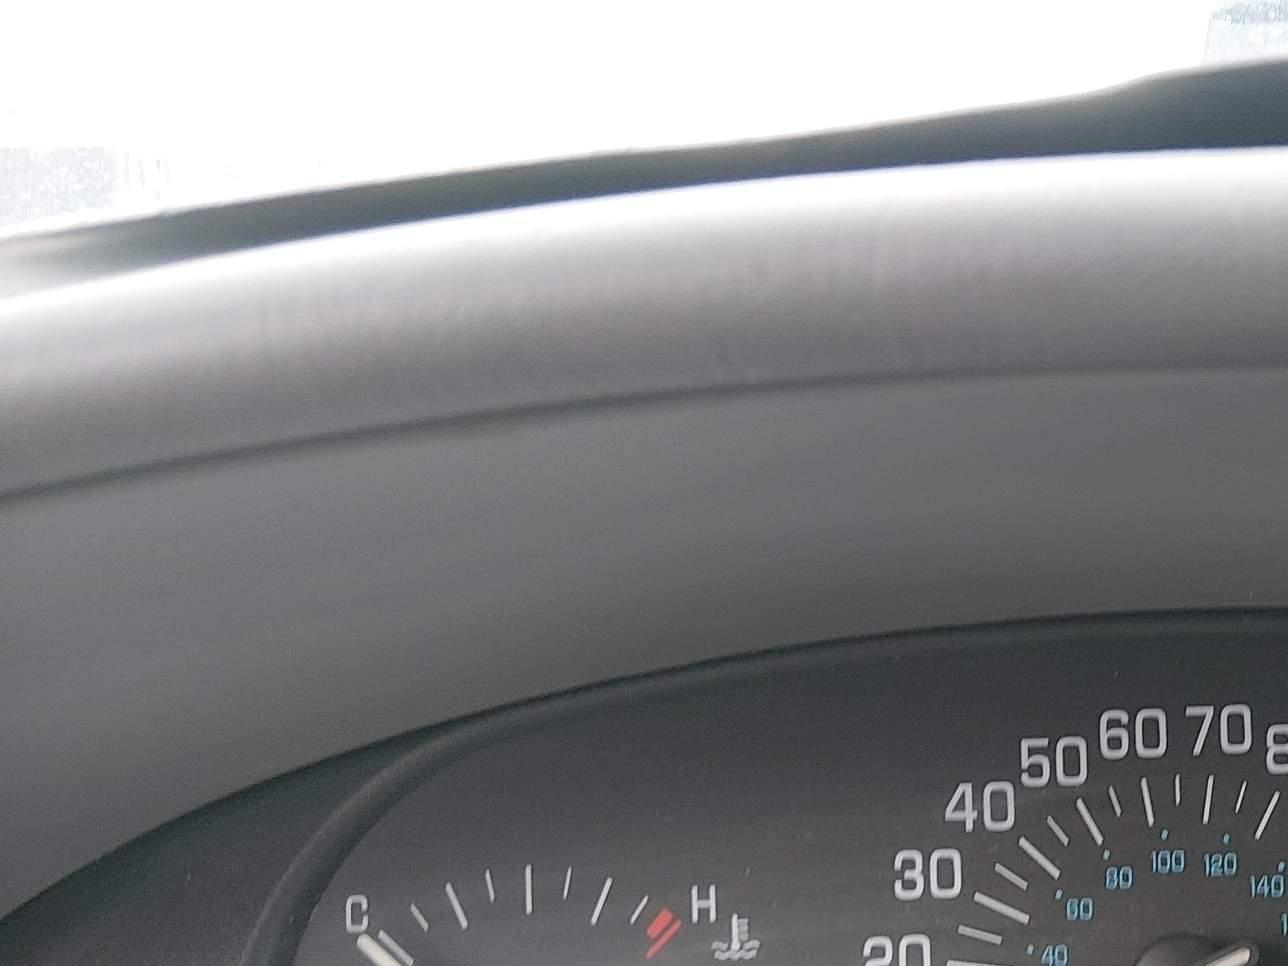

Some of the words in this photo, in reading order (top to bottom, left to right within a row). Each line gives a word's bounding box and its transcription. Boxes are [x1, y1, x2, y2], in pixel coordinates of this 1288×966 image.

[1100, 708, 1168, 760] 60
[1186, 703, 1253, 756] 70
[1020, 735, 1088, 788] 50
[945, 781, 1016, 833] 40
[893, 848, 962, 901] 30
[1105, 866, 1133, 890] 80
[1150, 848, 1185, 873] 100
[1202, 851, 1237, 877] 120
[690, 883, 718, 924] H
[1249, 874, 1285, 899] 140
[345, 894, 369, 934] C
[1066, 897, 1094, 921] 60
